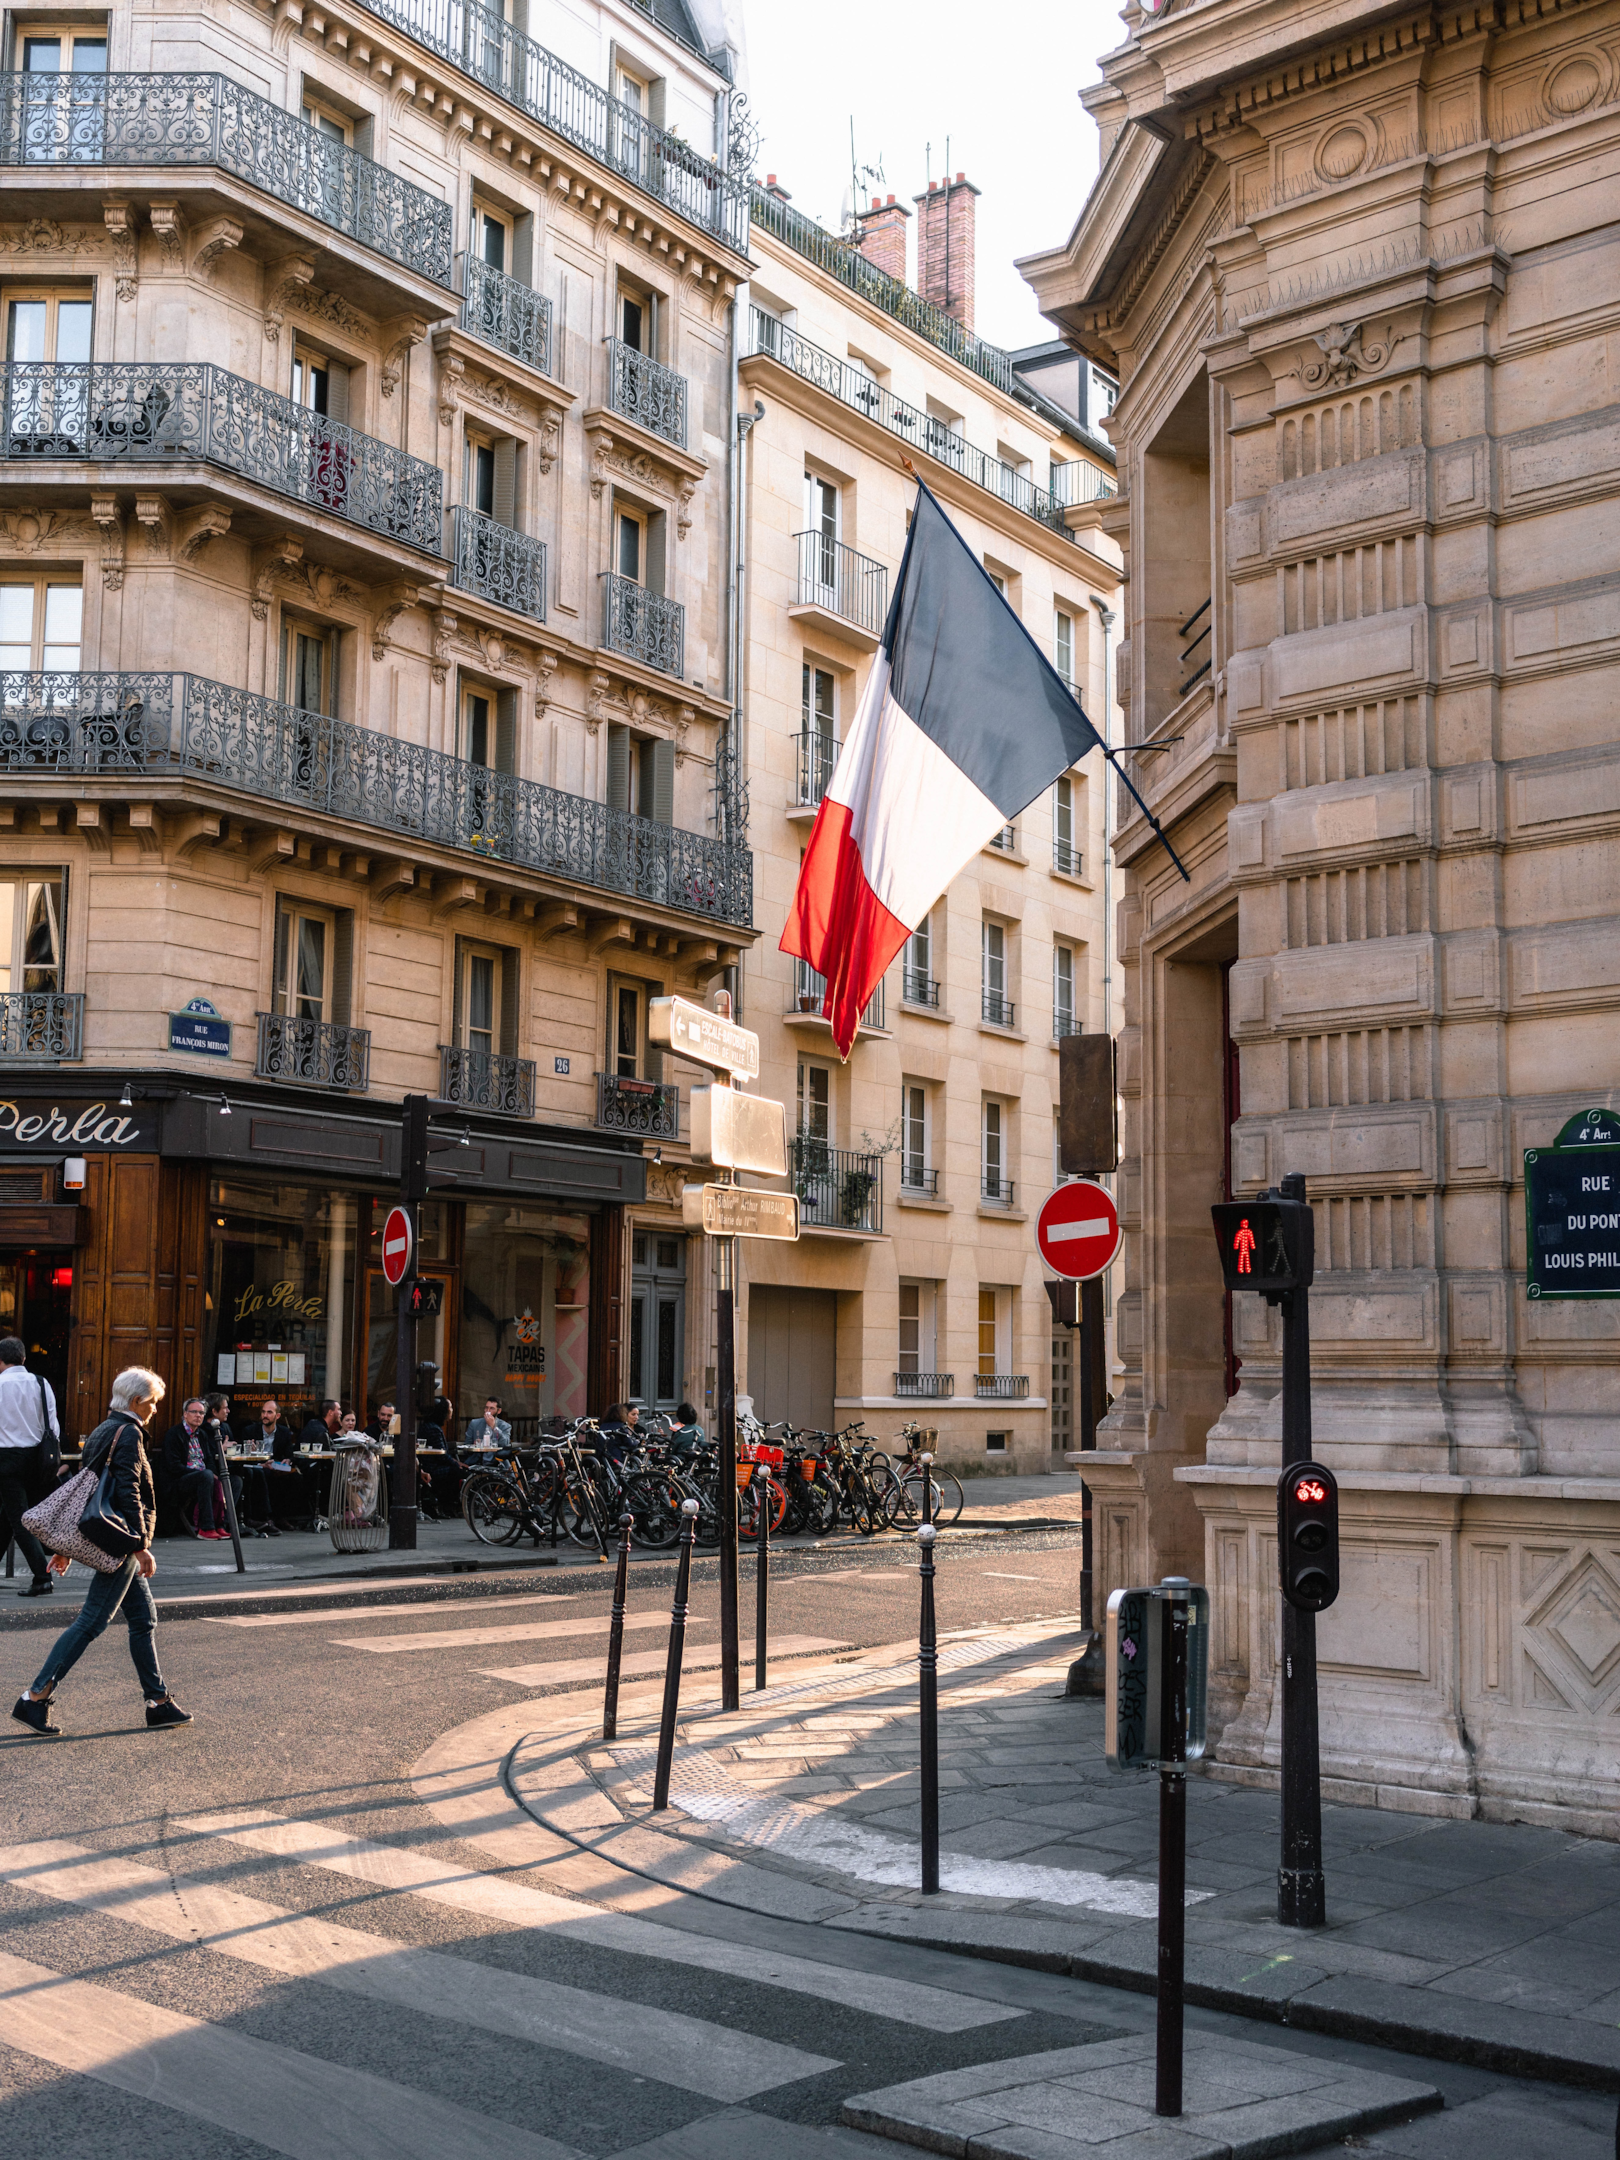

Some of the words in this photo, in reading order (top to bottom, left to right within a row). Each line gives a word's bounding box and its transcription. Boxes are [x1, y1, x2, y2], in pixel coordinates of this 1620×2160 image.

[194, 1025, 208, 1034] RUE
[701, 1020, 747, 1051] ESCALE-BATOBUS
[172, 1036, 206, 1049] FRANÇOIS
[207, 1041, 229, 1052] MIRON
[721, 1046, 729, 1059] DE
[731, 1050, 745, 1065] VILLE
[556, 1058, 568, 1073] 26
[1581, 1175, 1610, 1192] RUE
[740, 1197, 759, 1213] Arthur
[760, 1200, 786, 1216] RIMBAUD
[717, 1213, 734, 1226] Mairie
[735, 1215, 742, 1227] du
[1567, 1214, 1587, 1231] DU
[1544, 1252, 1585, 1269] LOUIS
[1588, 1251, 1620, 1268] PHIL
[234, 1284, 264, 1322] La
[266, 1280, 323, 1320] Perla
[252, 1319, 306, 1342] BAR
[508, 1345, 545, 1363] TAPAS
[507, 1363, 545, 1373] MEXICAINS
